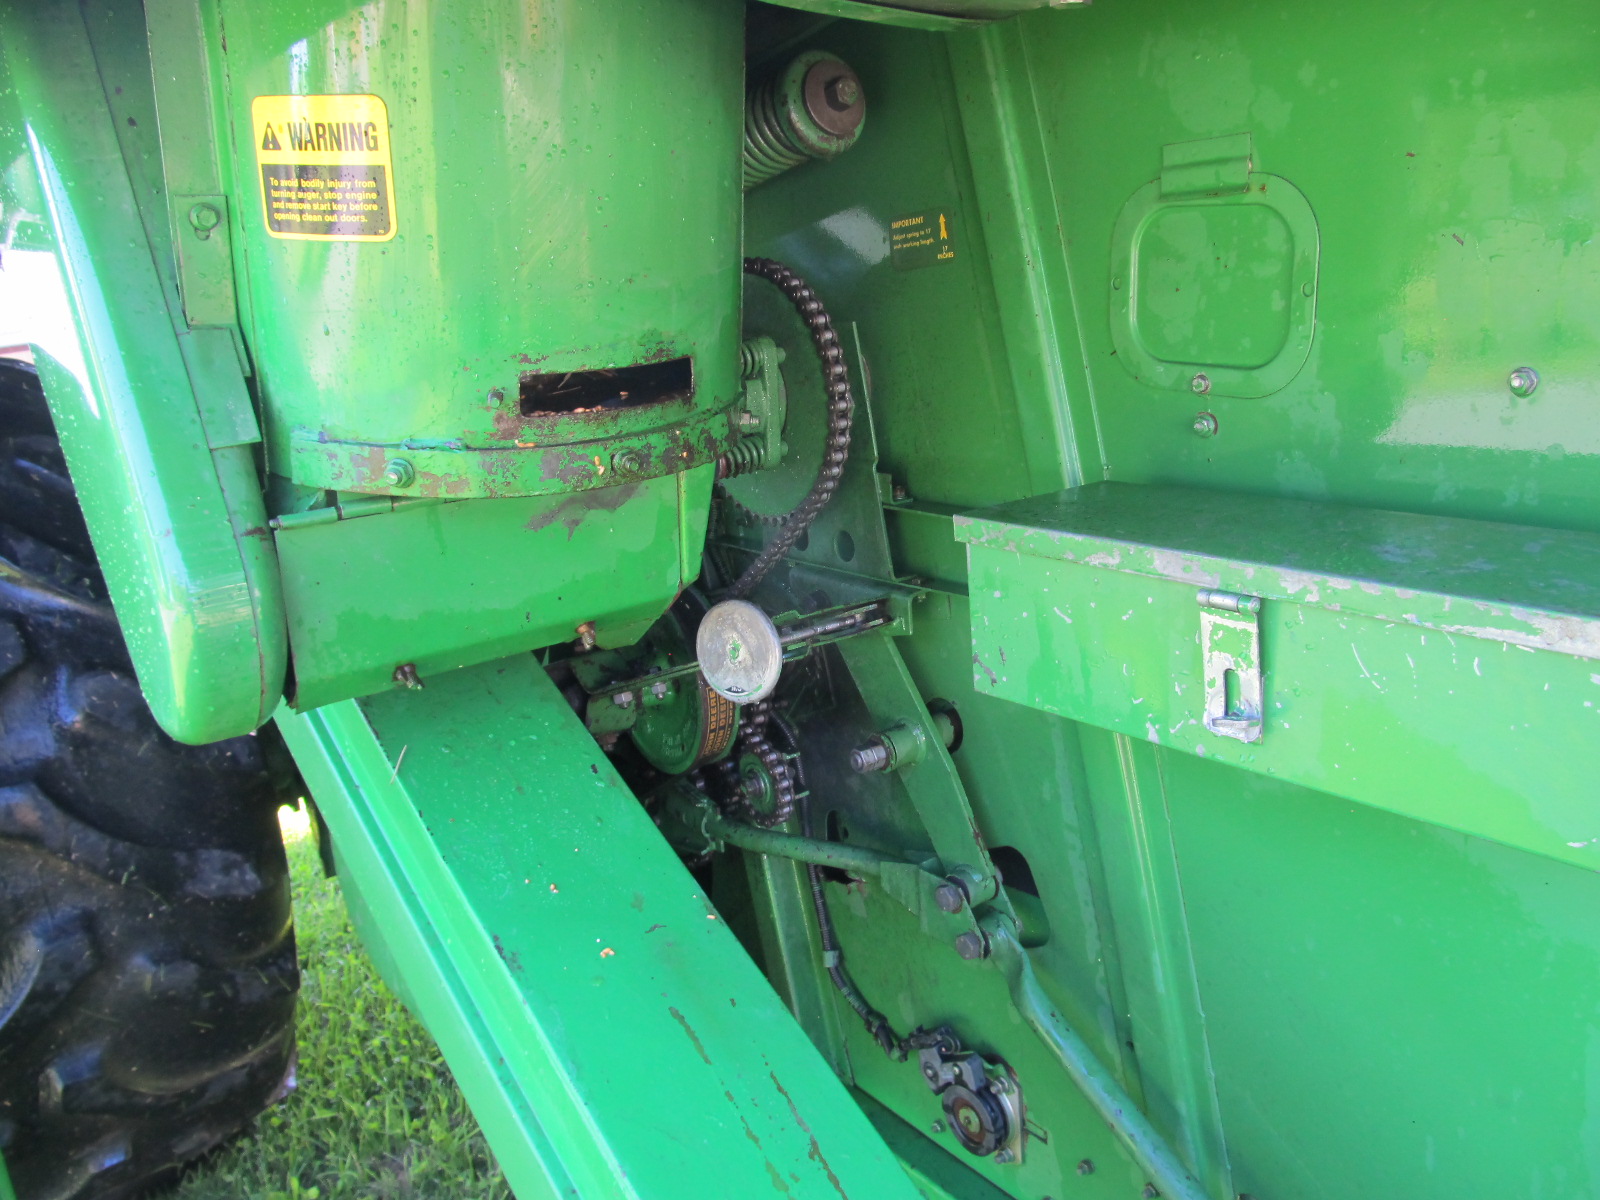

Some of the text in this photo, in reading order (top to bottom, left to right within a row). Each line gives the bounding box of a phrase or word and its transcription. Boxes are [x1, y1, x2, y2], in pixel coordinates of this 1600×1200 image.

[287, 121, 379, 151] WARNING
[269, 177, 376, 190] To avoid bodily injury from
[271, 190, 377, 201] turning auger, stop engine
[272, 200, 378, 212] and remove start key before
[274, 213, 368, 222] opening clean out doors.
[892, 216, 923, 229] IMPORTANT
[704, 732, 715, 754] JOHN
[713, 730, 724, 751] JOHN
